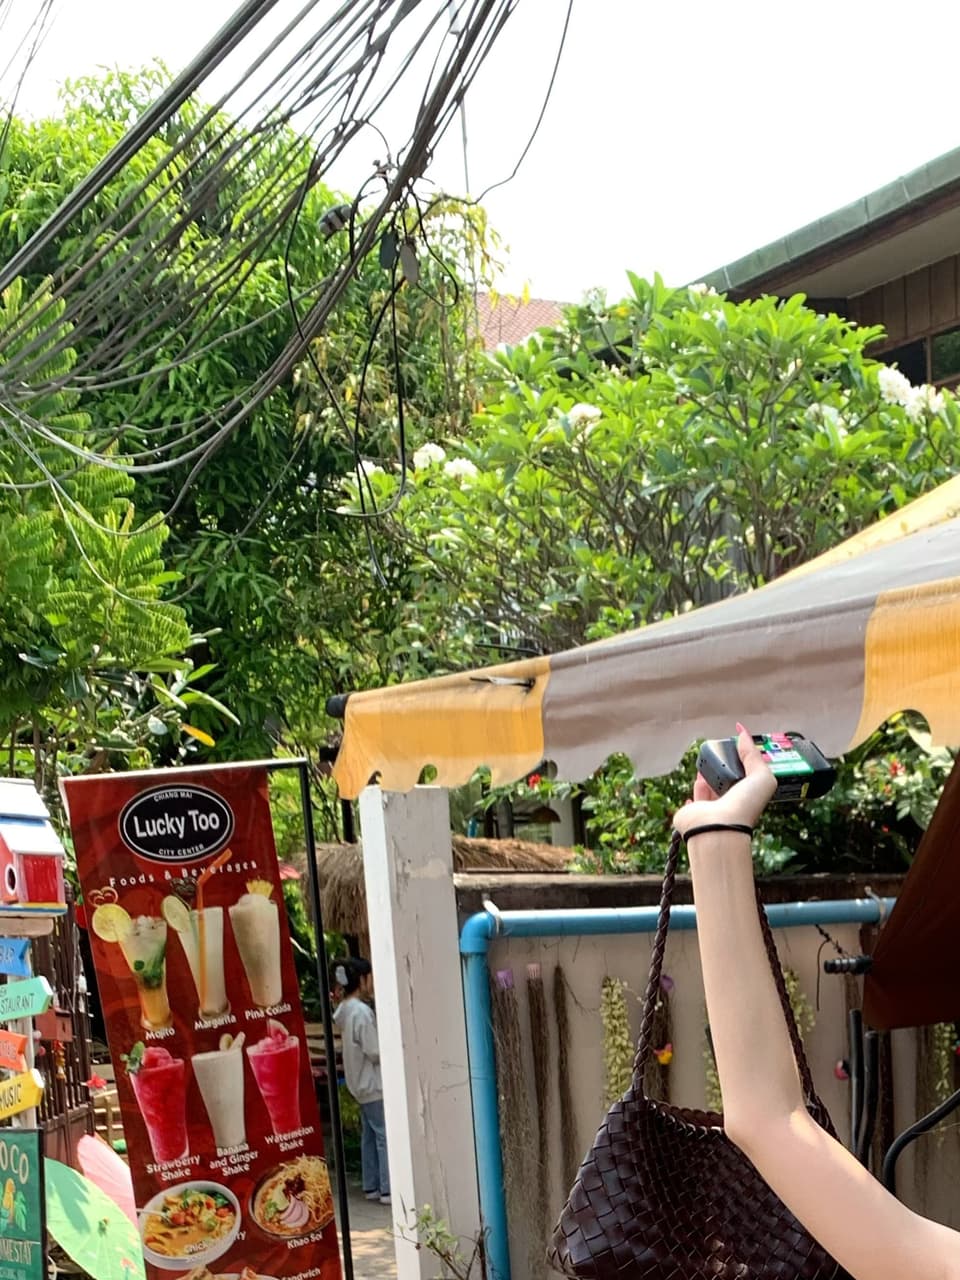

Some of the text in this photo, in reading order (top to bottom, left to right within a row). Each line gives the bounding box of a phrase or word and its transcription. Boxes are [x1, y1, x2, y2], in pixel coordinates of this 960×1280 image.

[154, 791, 193, 802] CHIANG MAI
[133, 809, 220, 839] Lucky Too
[158, 843, 205, 856] CITY CENTER
[109, 873, 155, 888] Foods
[181, 860, 257, 878] Beverages
[194, 1014, 237, 1031] Margarita
[145, 1027, 175, 1040] Mojito
[264, 1126, 315, 1145] Watermelon
[217, 1143, 250, 1157] Banana
[279, 1139, 304, 1152] Shake
[146, 1155, 200, 1174] Strawberry
[209, 1151, 259, 1169] and Ginger
[161, 1168, 191, 1182] Shake
[222, 1163, 250, 1177] Shake
[287, 1237, 310, 1250] Khao
